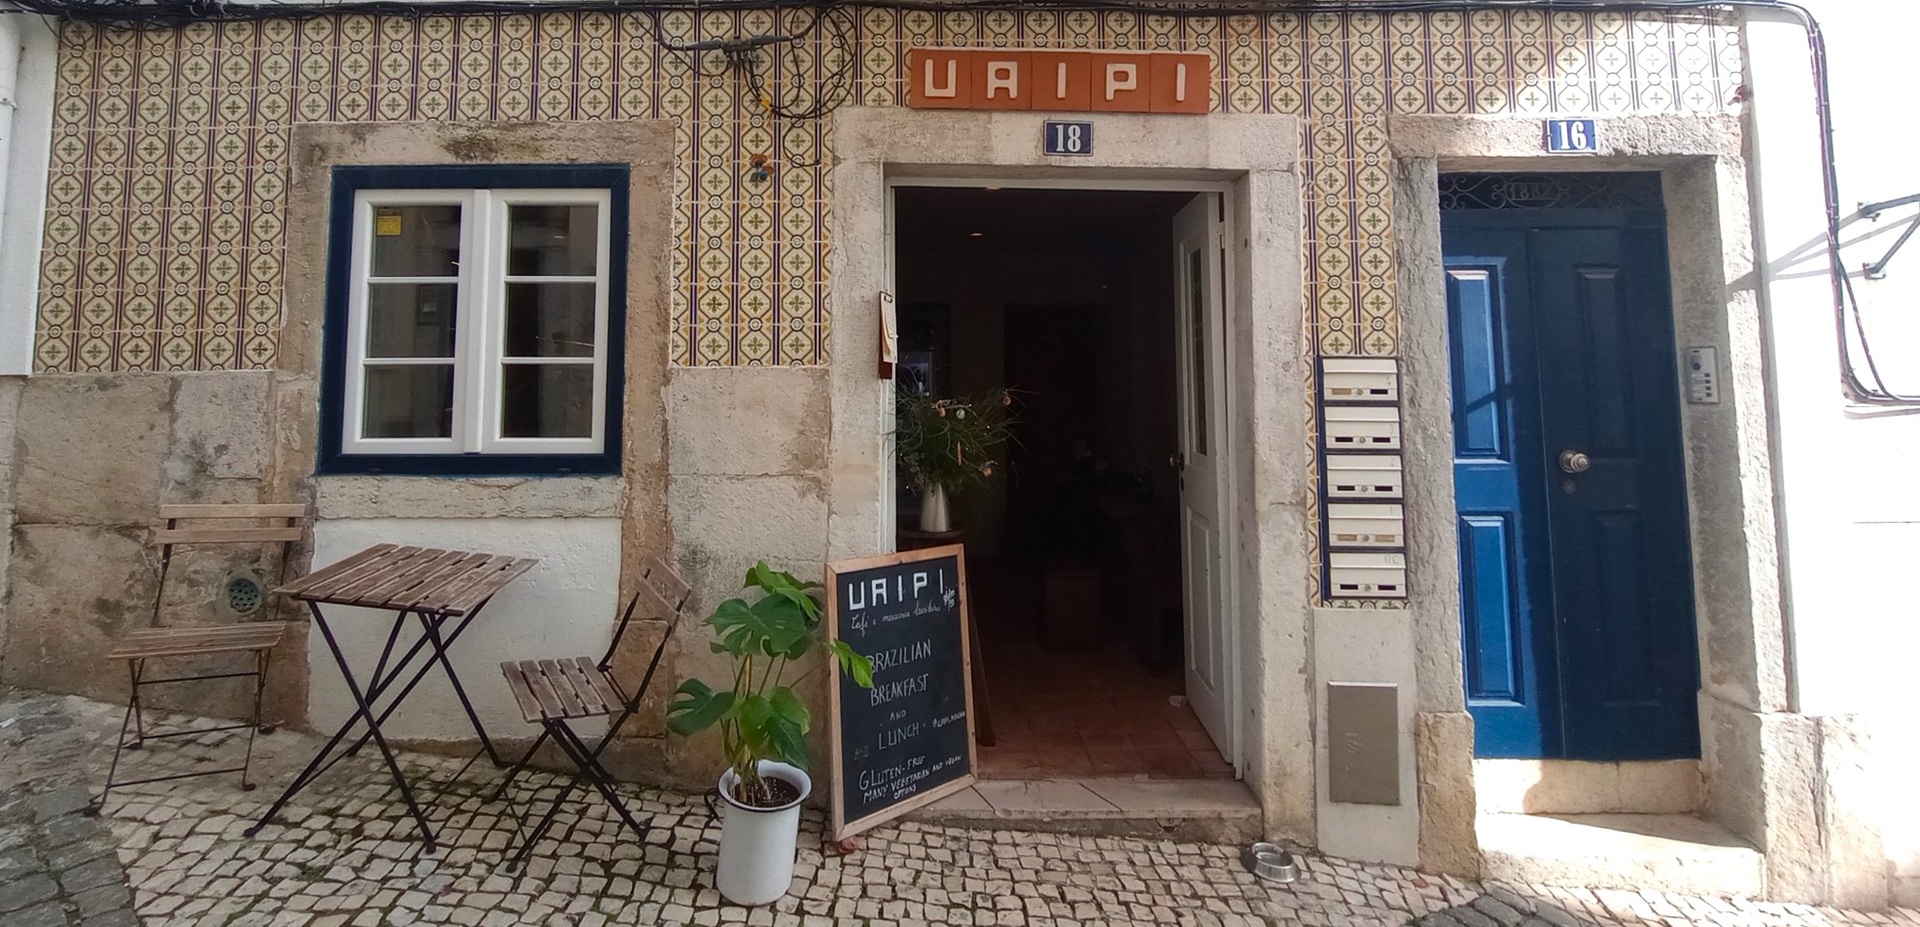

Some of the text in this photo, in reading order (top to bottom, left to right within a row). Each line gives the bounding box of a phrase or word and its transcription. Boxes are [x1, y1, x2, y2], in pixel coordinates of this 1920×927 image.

[924, 58, 1186, 102] UAIPI
[1055, 124, 1082, 153] 18
[1557, 121, 1587, 150] 16
[848, 568, 943, 610] UAIPI
[870, 673, 929, 707] BREAKFAST
[889, 709, 907, 722] AND
[878, 721, 920, 750] LUNCH
[863, 784, 889, 804] MANY
[932, 762, 943, 772] AND
